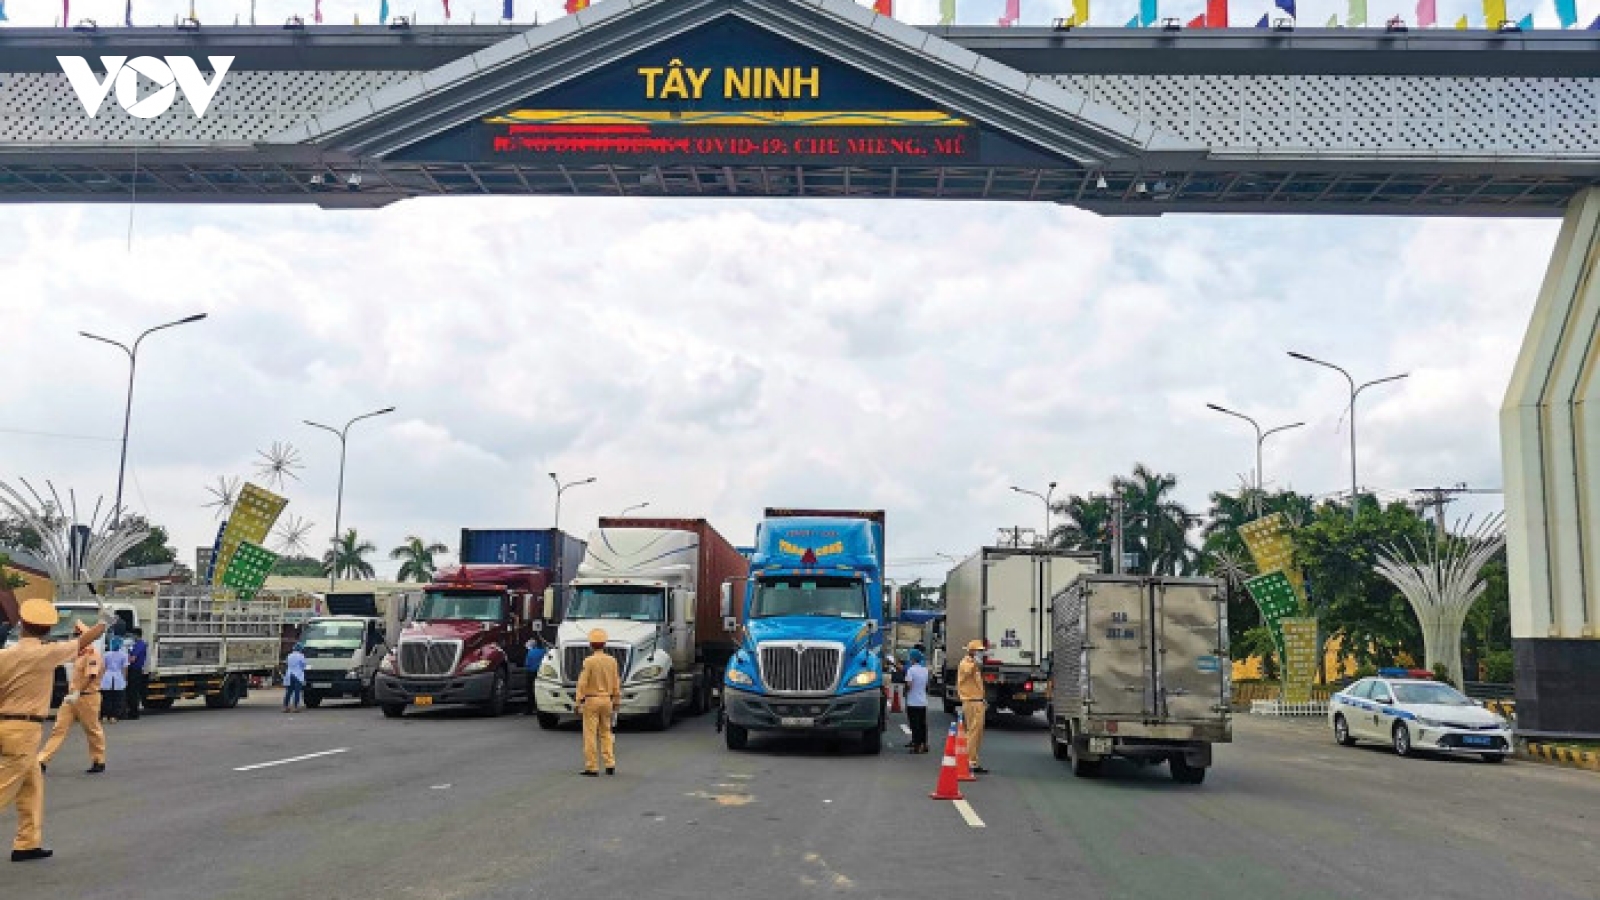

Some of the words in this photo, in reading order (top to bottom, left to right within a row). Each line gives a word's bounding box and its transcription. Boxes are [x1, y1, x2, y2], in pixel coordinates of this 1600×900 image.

[638, 58, 711, 98] TÂY
[723, 67, 820, 98] NINH
[498, 543, 518, 563] 45
